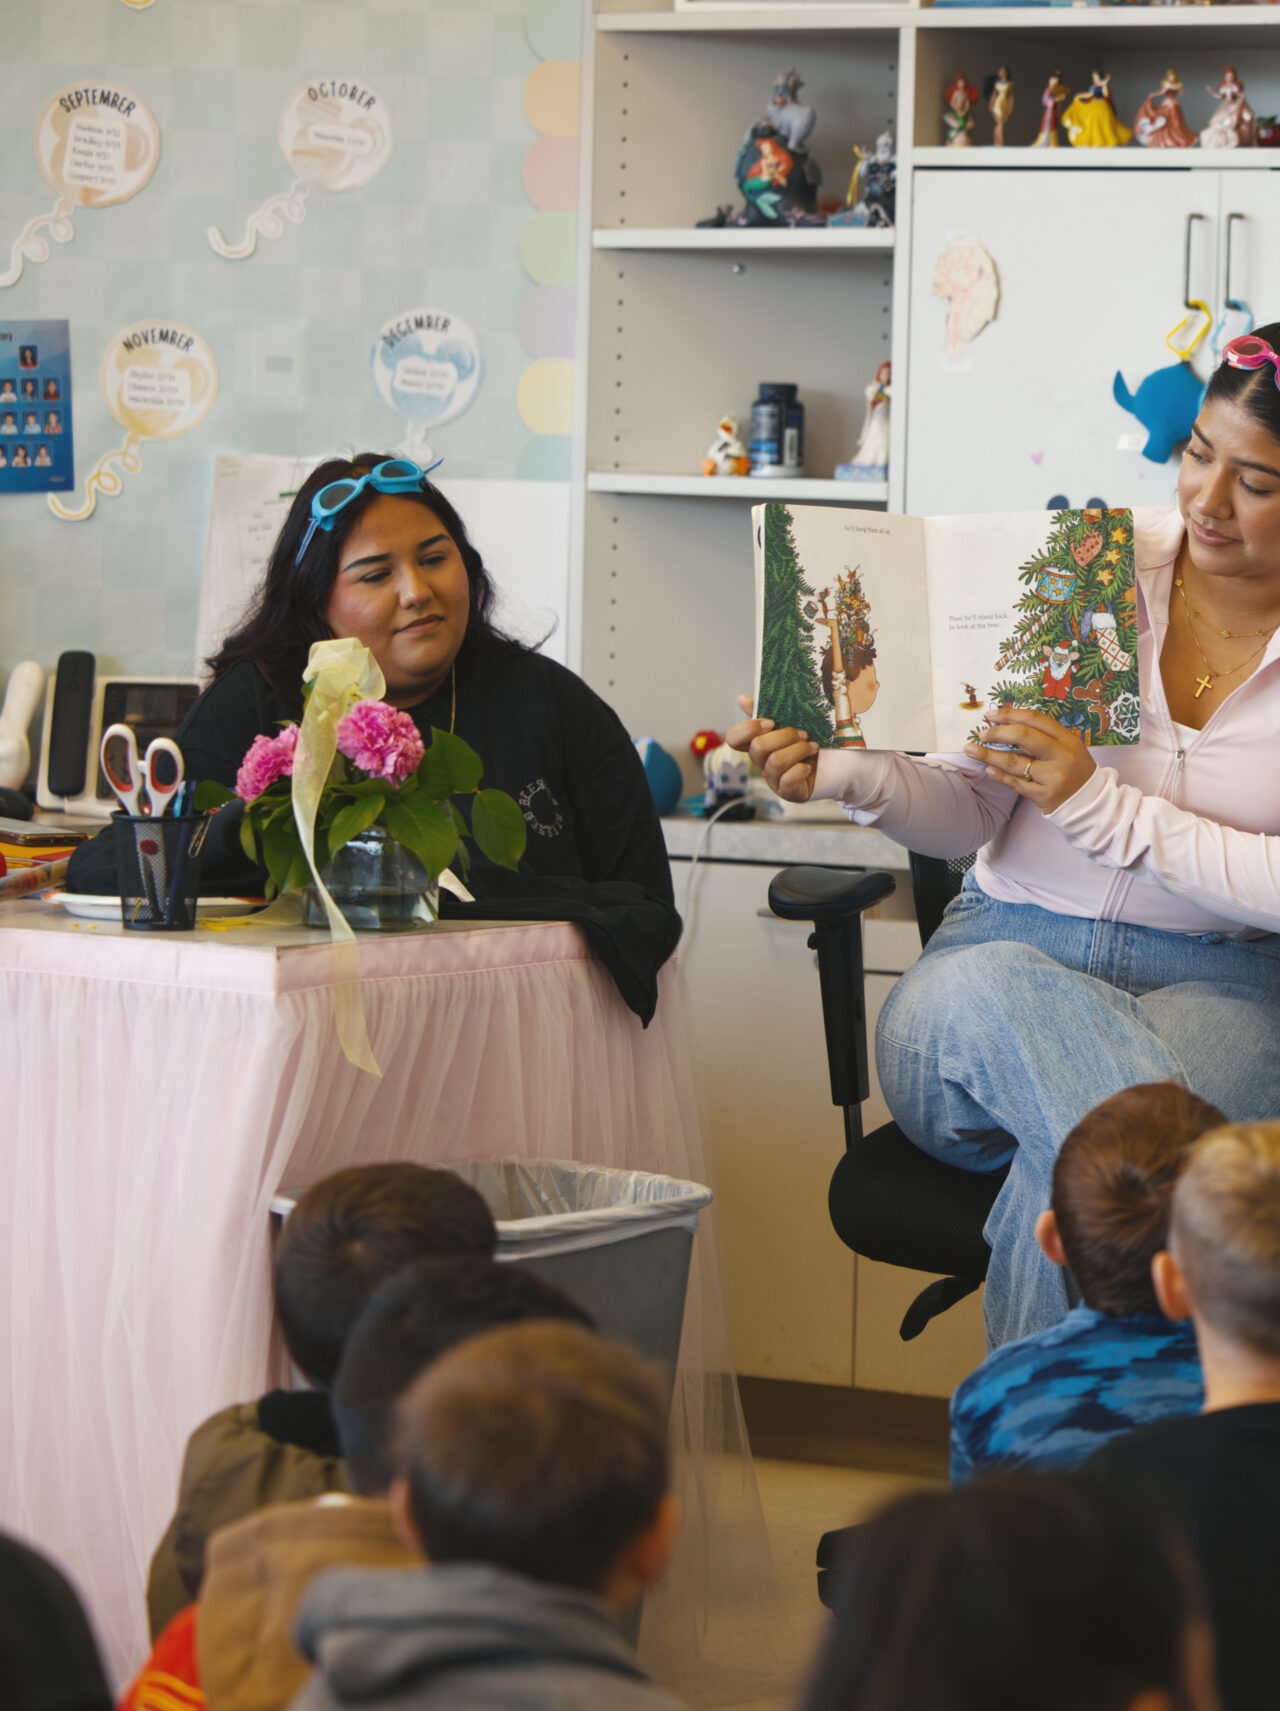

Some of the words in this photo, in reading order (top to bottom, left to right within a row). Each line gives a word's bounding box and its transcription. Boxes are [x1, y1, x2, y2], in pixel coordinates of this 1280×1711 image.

[59, 88, 136, 117] SEPTEMBER
[307, 81, 376, 111] OCTOBER
[122, 328, 194, 354] NOVEMBER
[382, 315, 450, 348] DECEMBER
